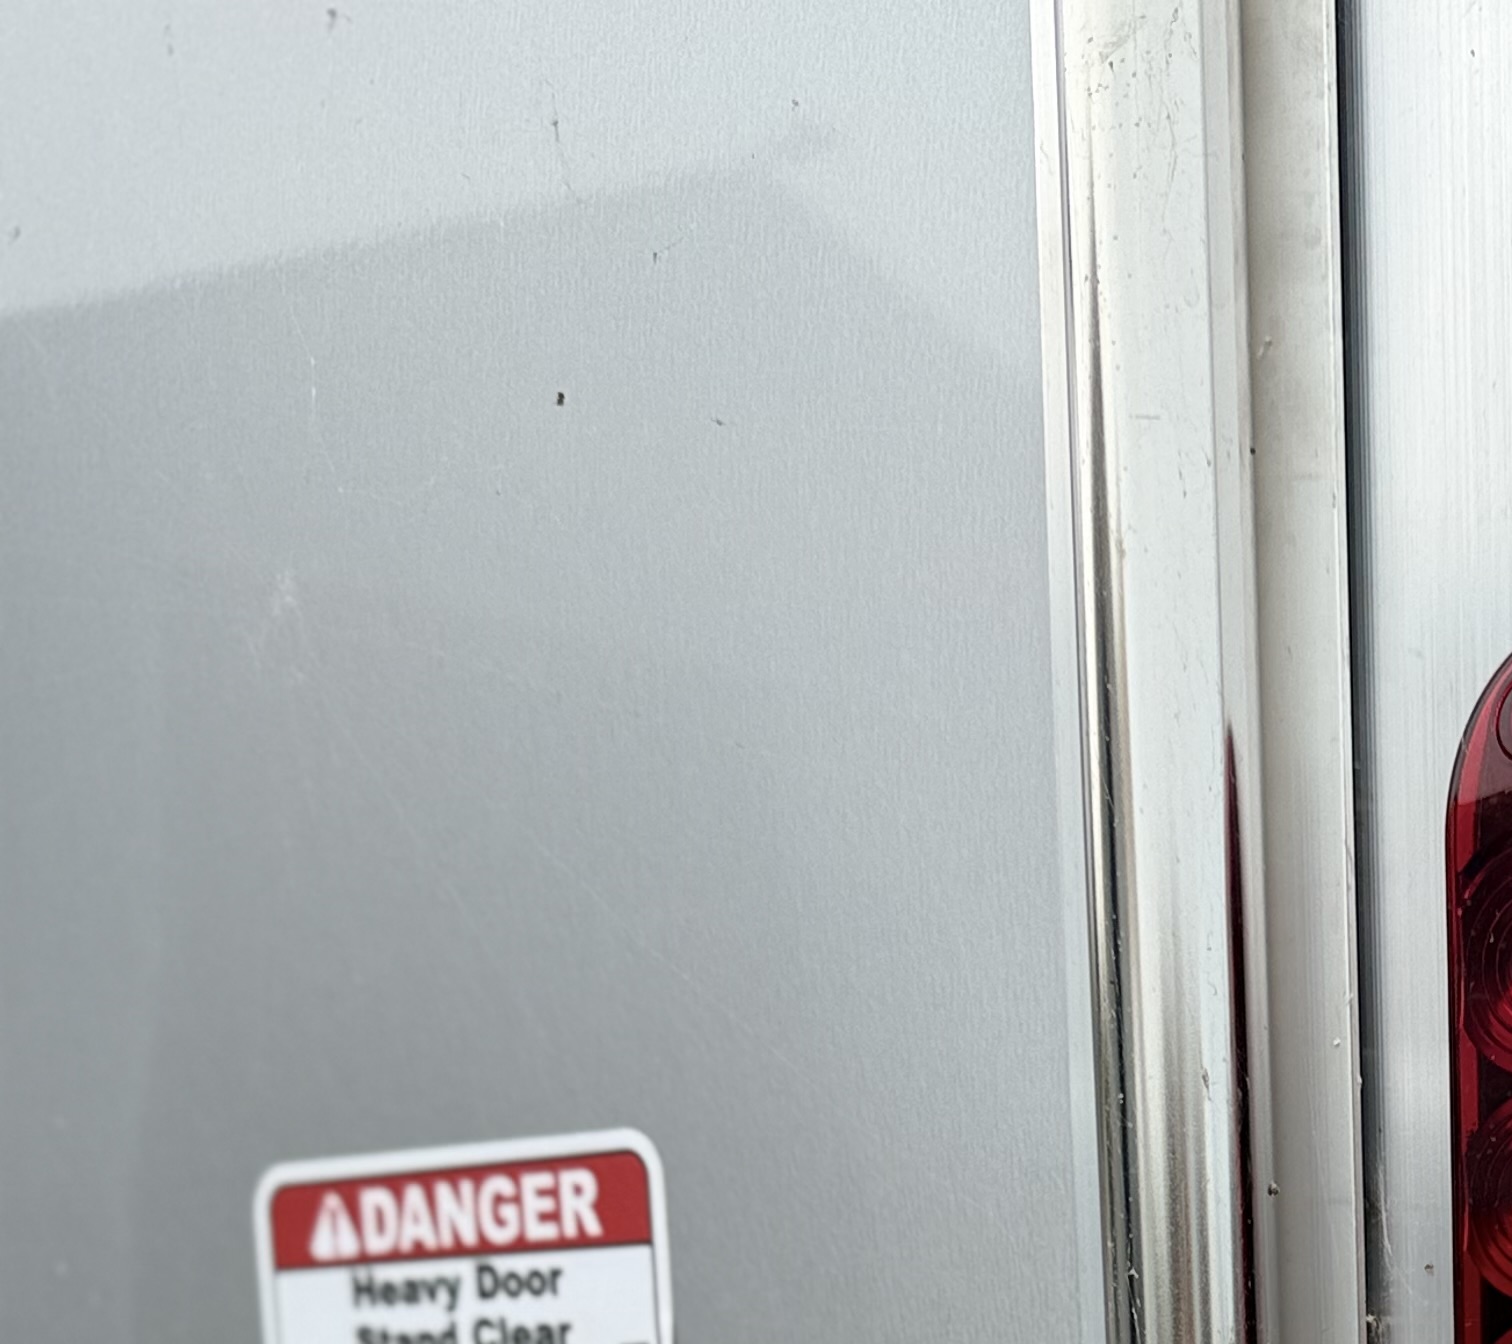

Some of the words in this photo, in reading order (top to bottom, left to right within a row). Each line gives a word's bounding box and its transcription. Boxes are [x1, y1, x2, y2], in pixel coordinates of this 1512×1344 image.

[358, 1168, 603, 1256] DANGER
[351, 1268, 461, 1312] Heavy
[475, 1263, 562, 1300] Door
